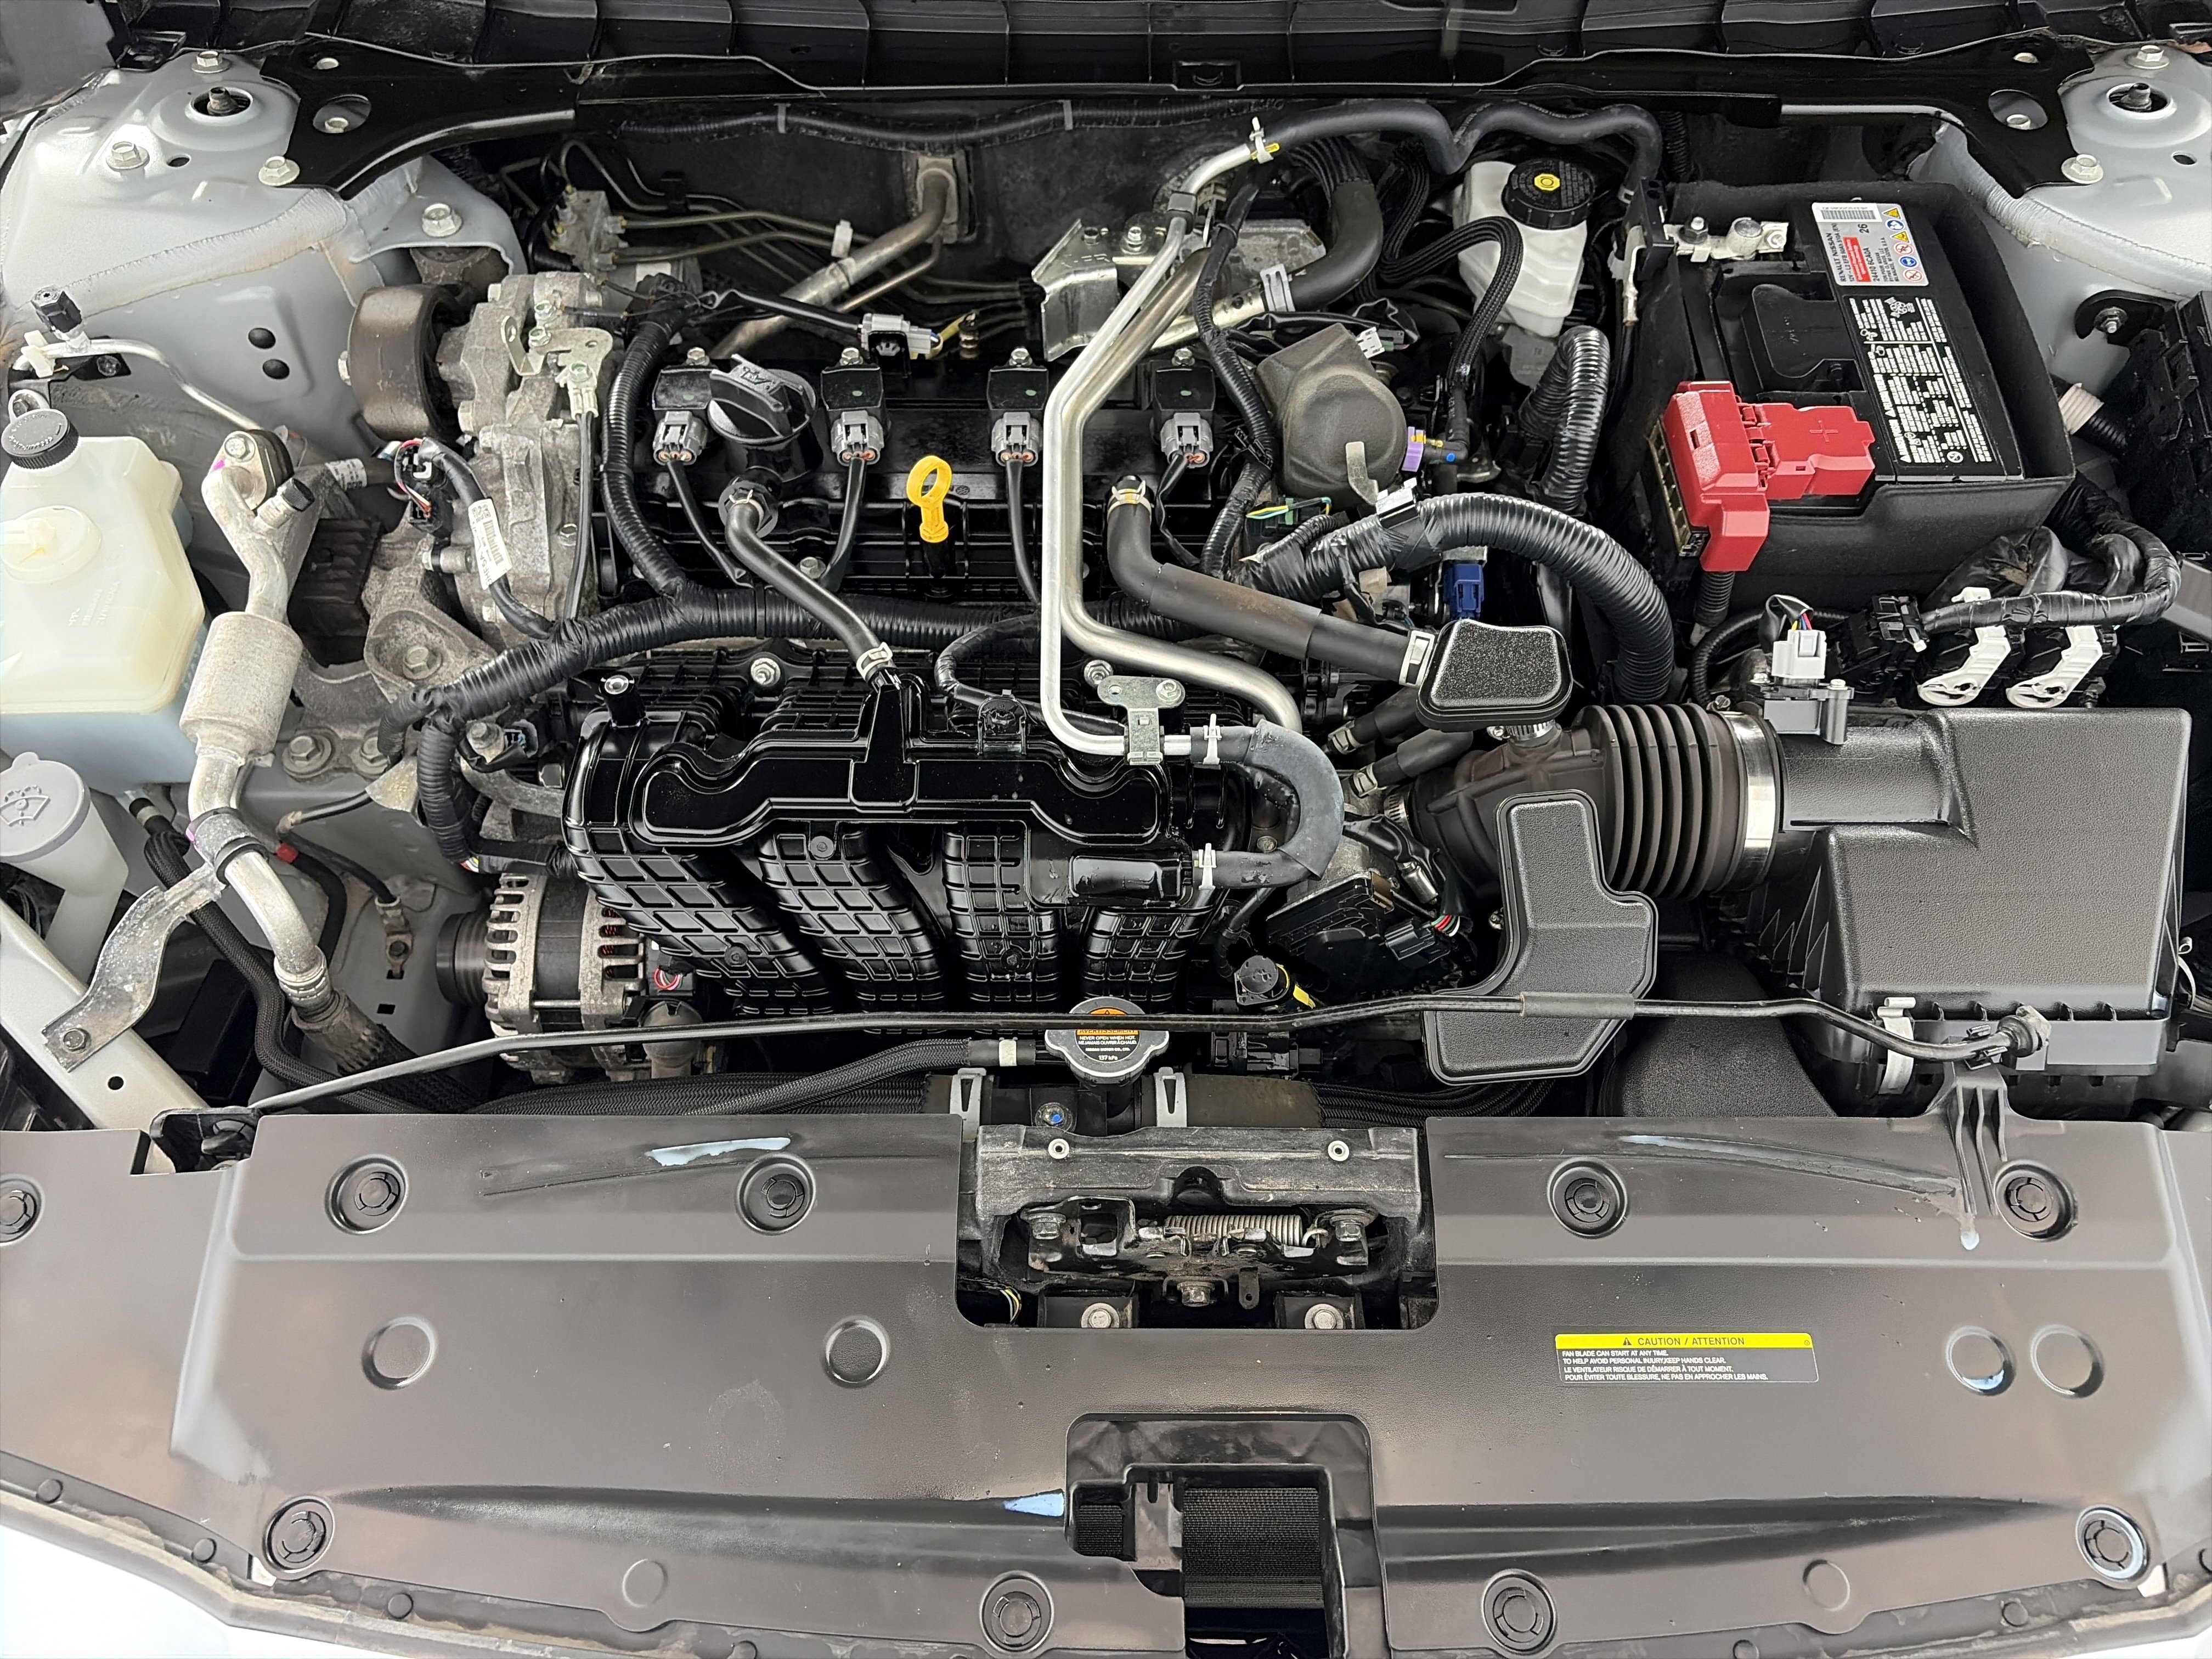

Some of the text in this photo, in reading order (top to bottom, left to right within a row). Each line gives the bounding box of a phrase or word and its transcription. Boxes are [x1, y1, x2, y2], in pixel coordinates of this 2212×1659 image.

[1858, 223, 1869, 233] 26
[1826, 232, 1846, 281] RENAULT NISSAN
[1870, 266, 1880, 281] 24410
[1638, 1337, 1681, 1346] CAUTION
[1682, 1337, 1688, 1346] /
[1584, 1372, 1605, 1380] ÉVITER
